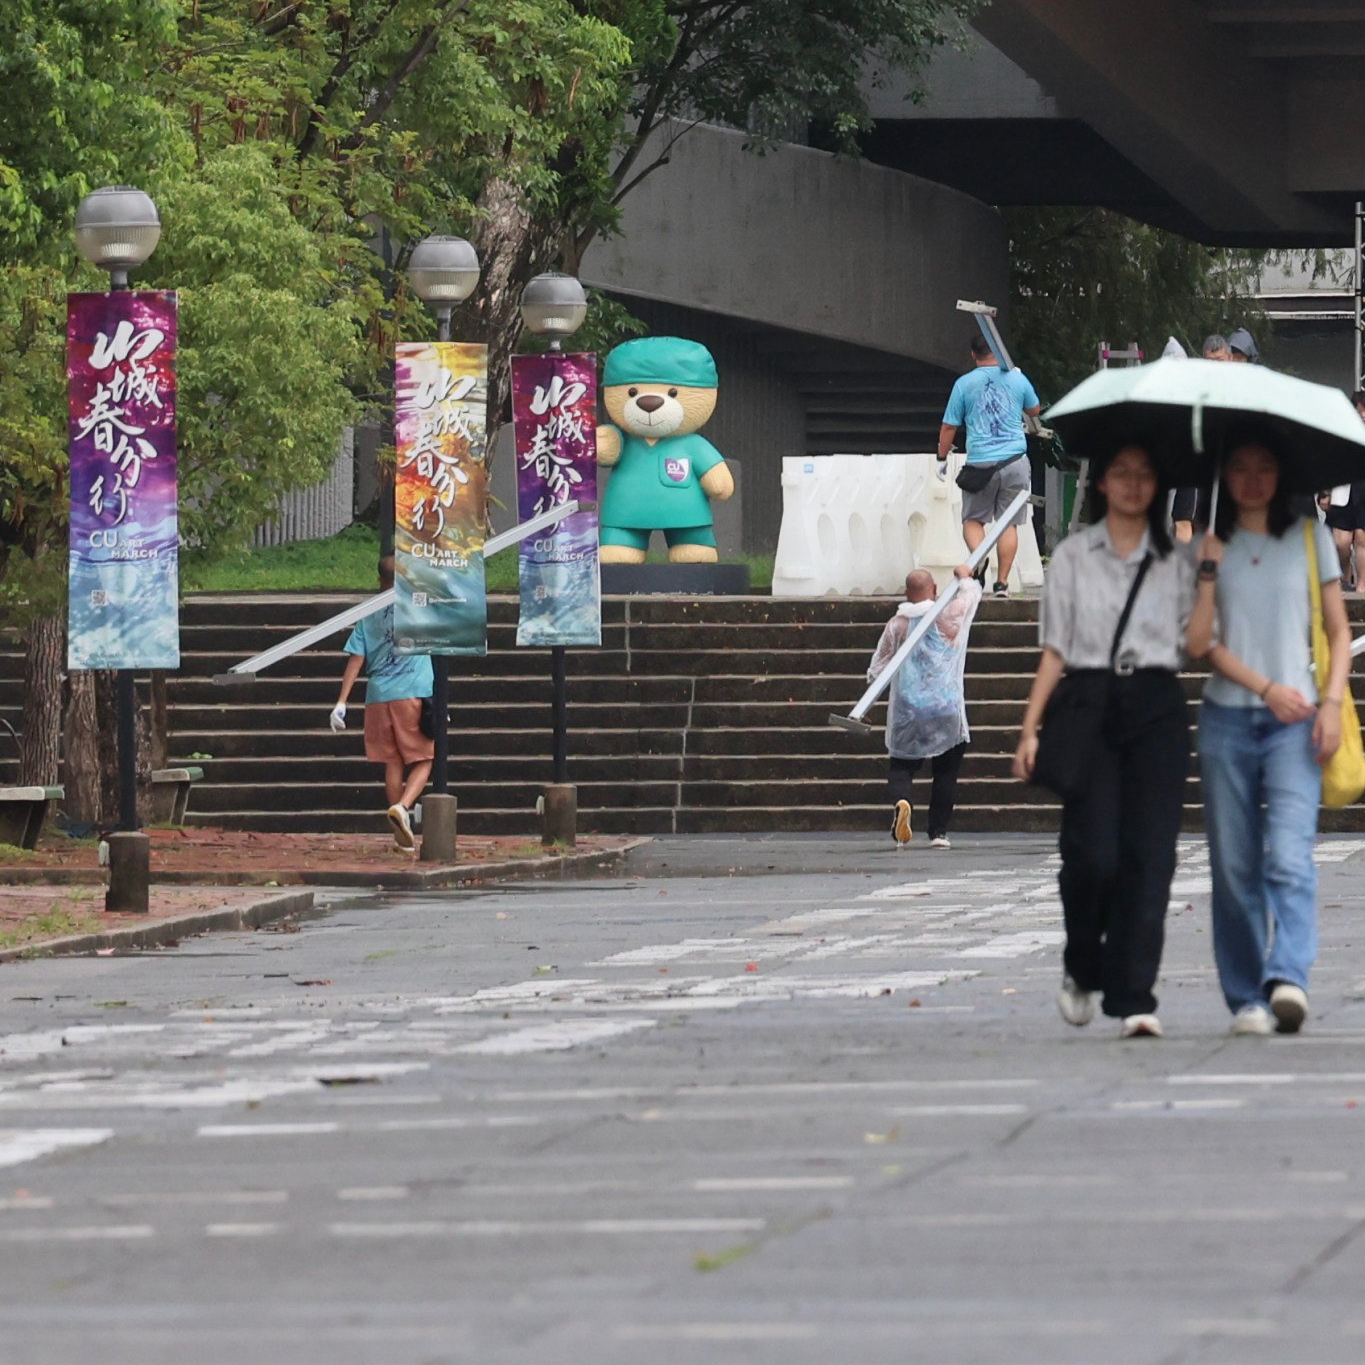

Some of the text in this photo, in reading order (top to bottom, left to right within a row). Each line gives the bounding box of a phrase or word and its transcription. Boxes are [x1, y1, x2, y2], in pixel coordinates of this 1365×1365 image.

[90, 531, 144, 547] CU ART
[411, 543, 457, 558] CU ART
[534, 540, 553, 552] CU
[111, 550, 158, 558] MARCH
[549, 553, 584, 561] MARCH
[429, 559, 468, 567] MARCH
